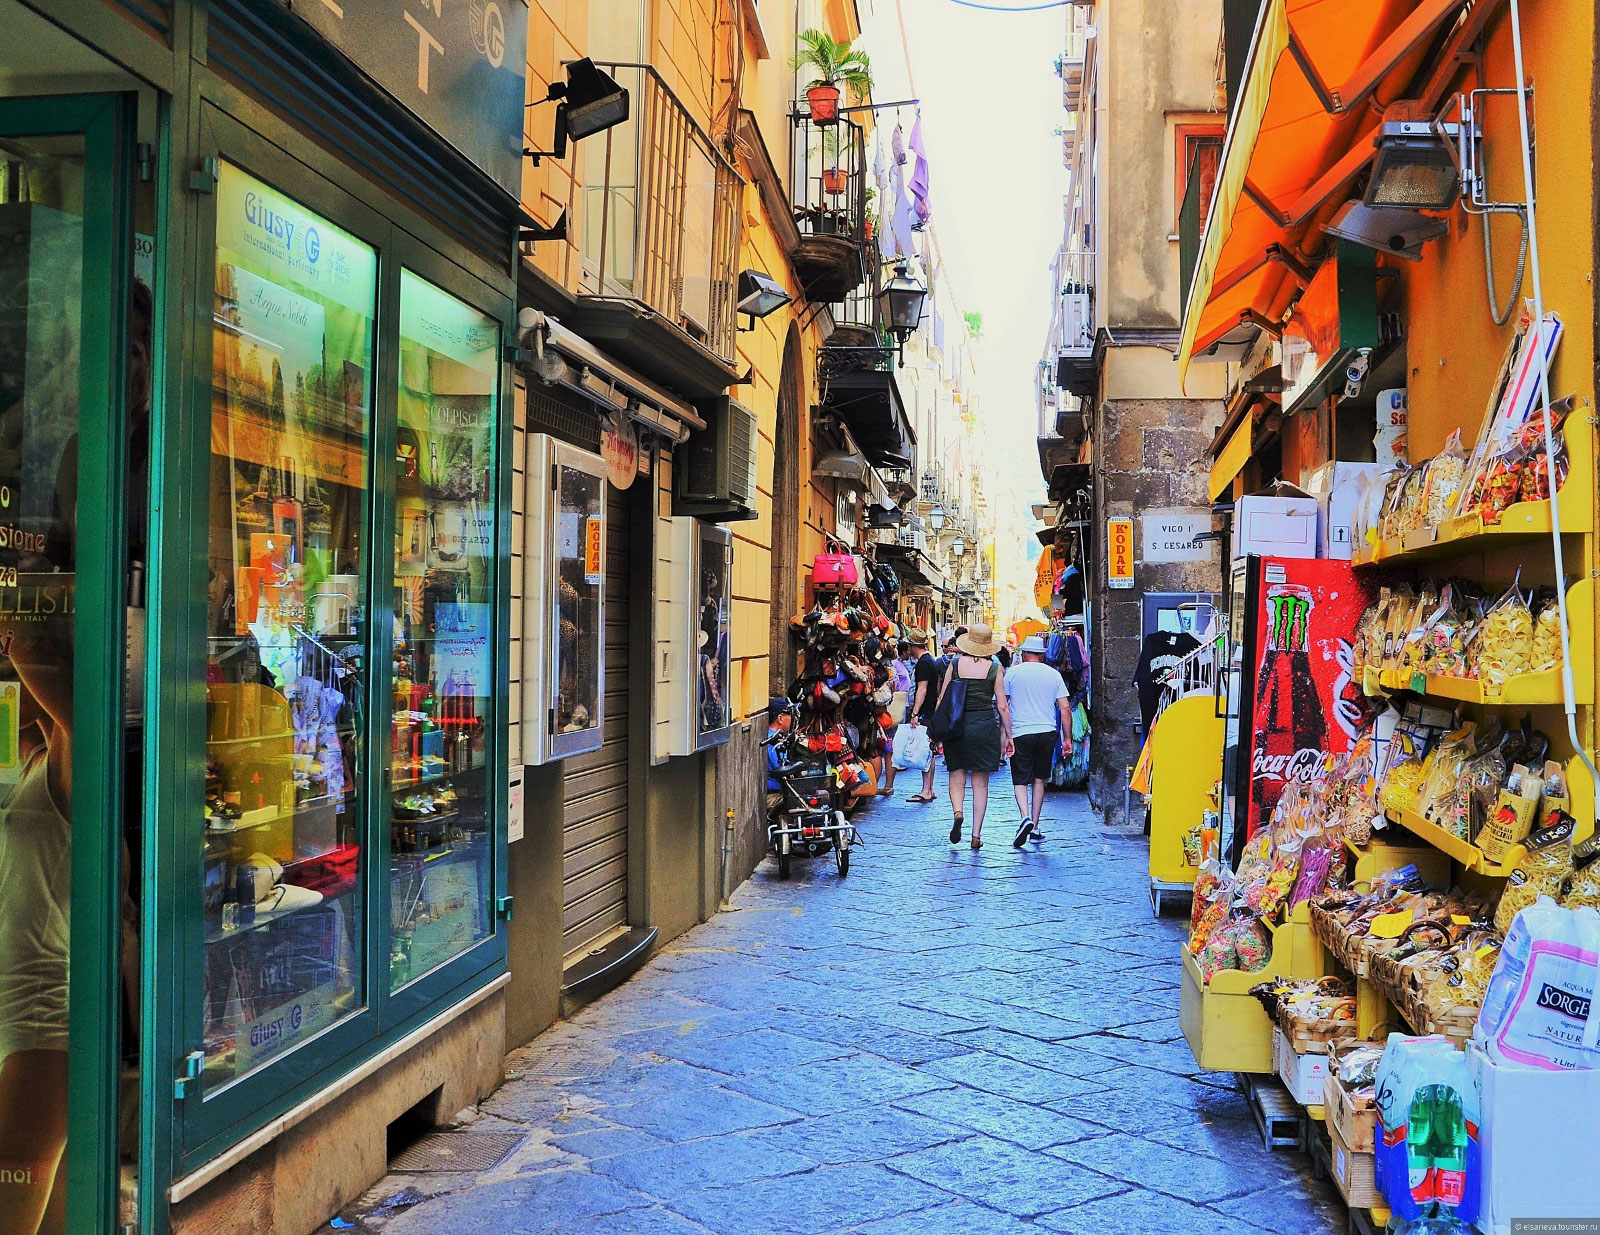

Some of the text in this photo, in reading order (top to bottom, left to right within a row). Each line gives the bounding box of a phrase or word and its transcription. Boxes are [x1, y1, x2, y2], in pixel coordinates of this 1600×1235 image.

[244, 191, 294, 250] Giusy
[1161, 525, 1183, 533] VICO
[1115, 524, 1127, 576] KODAK
[1164, 542, 1203, 550] CESAREO
[1562, 981, 1584, 993] ACQUA
[1540, 985, 1590, 1016] SORGE
[250, 1016, 285, 1048] Giusy
[1559, 1058, 1577, 1069] Litri
